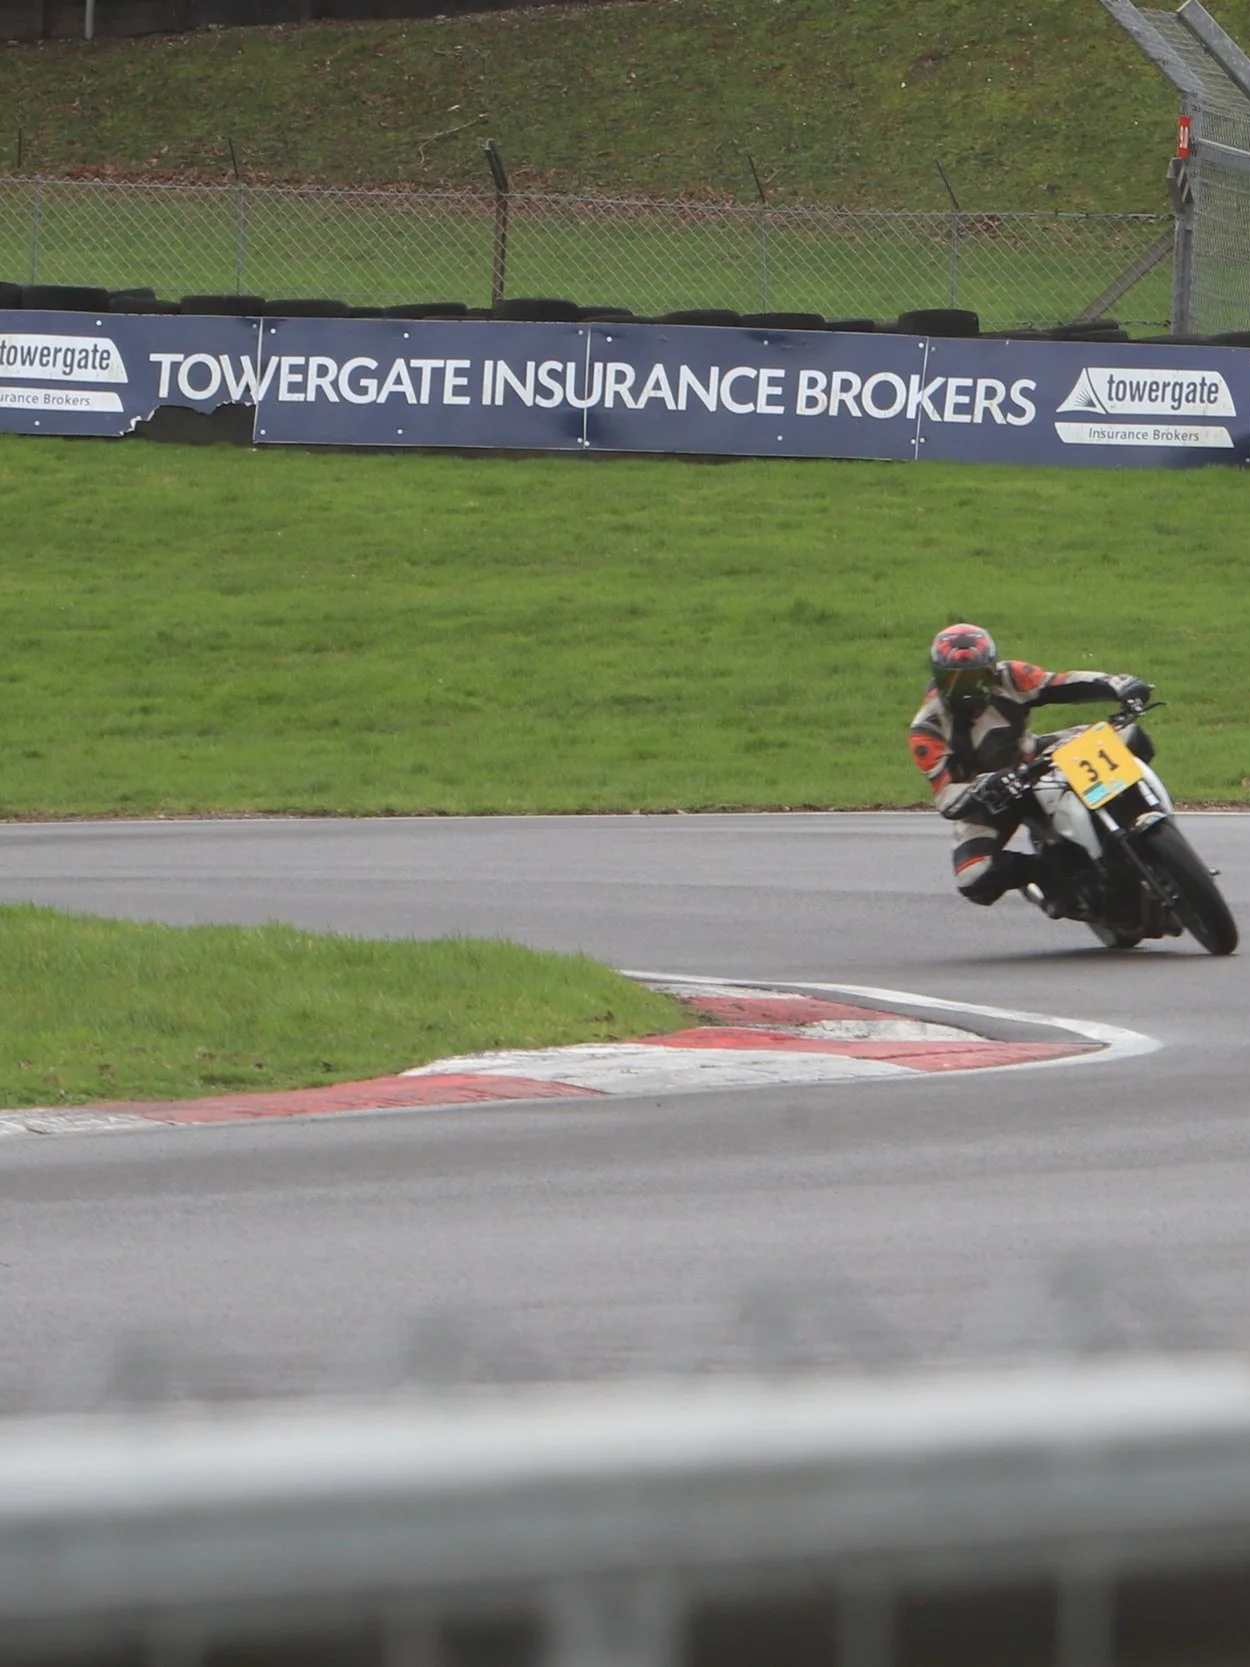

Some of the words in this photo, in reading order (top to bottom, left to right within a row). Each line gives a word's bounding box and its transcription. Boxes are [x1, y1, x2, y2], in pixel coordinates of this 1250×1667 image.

[0, 340, 111, 376] towergate
[43, 393, 91, 407] Brokers
[149, 352, 471, 405] TOWERGATE
[482, 359, 786, 415] INSURANCE
[796, 370, 1037, 426] BROKERS
[1107, 373, 1219, 411] towergate
[1088, 427, 1149, 440] Insurance
[1153, 428, 1200, 442] Brokers
[1079, 749, 1120, 782] 31
